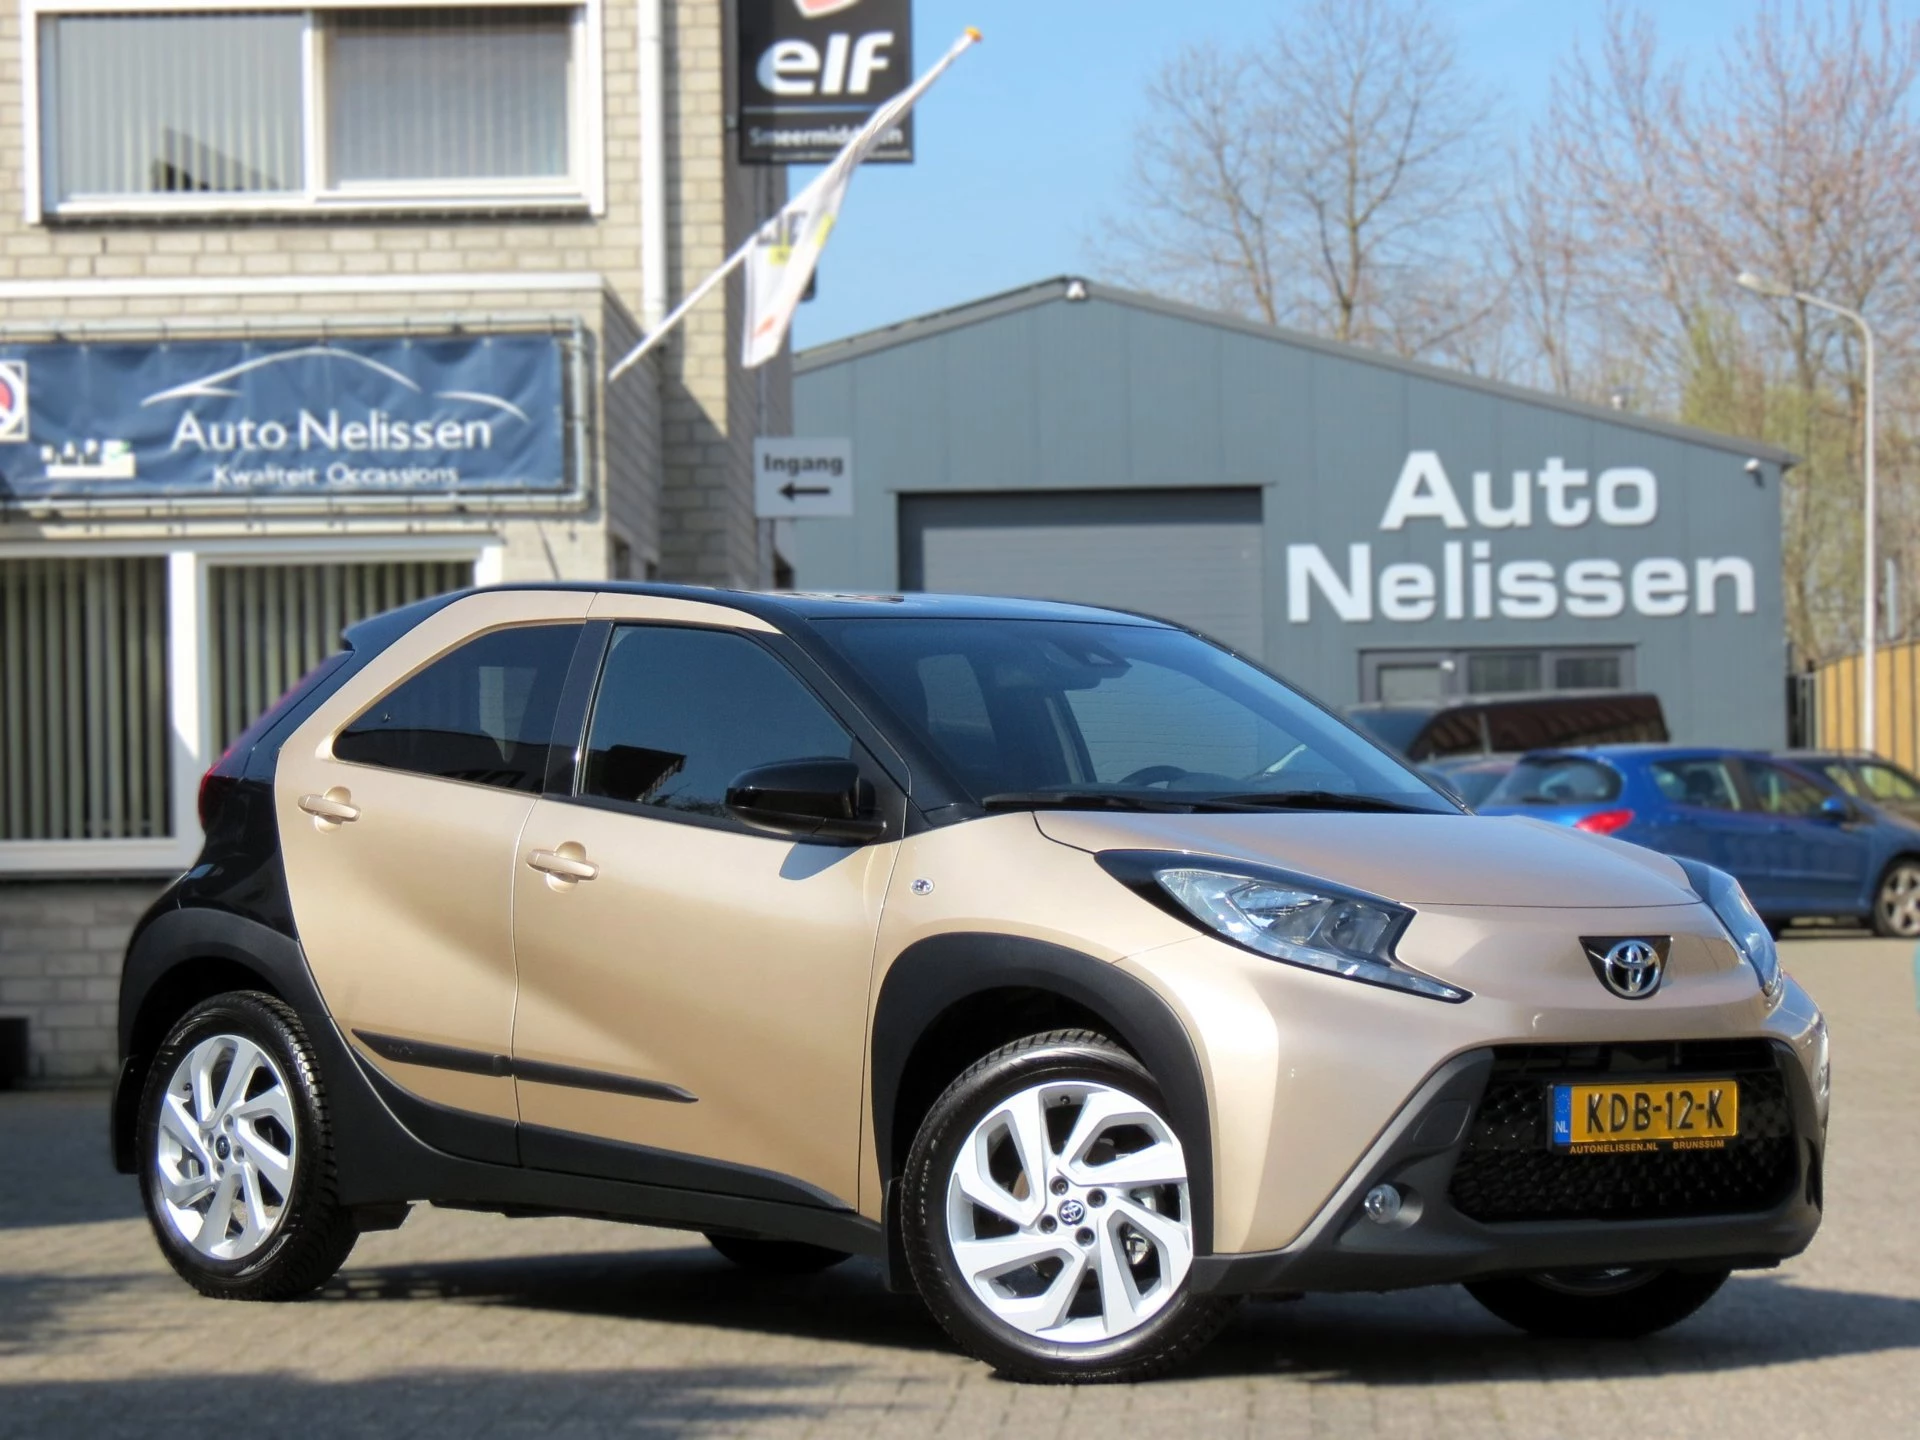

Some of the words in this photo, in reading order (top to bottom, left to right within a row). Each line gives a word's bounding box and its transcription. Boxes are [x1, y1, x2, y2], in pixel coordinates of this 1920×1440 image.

[756, 31, 894, 96] elf
[170, 408, 288, 451] Auto
[299, 408, 492, 451] Nelissen
[213, 461, 318, 488] Kwaliteit
[763, 453, 844, 477] Ingang
[1379, 450, 1658, 530] Auto
[1287, 540, 1756, 623] Nelissen
[1555, 1120, 1569, 1134] NL
[1587, 1089, 1724, 1134] KDB-12-K
[1570, 1142, 1659, 1155] AUTONELISSEN.NL
[1672, 1139, 1725, 1151] BRUNSSUM
